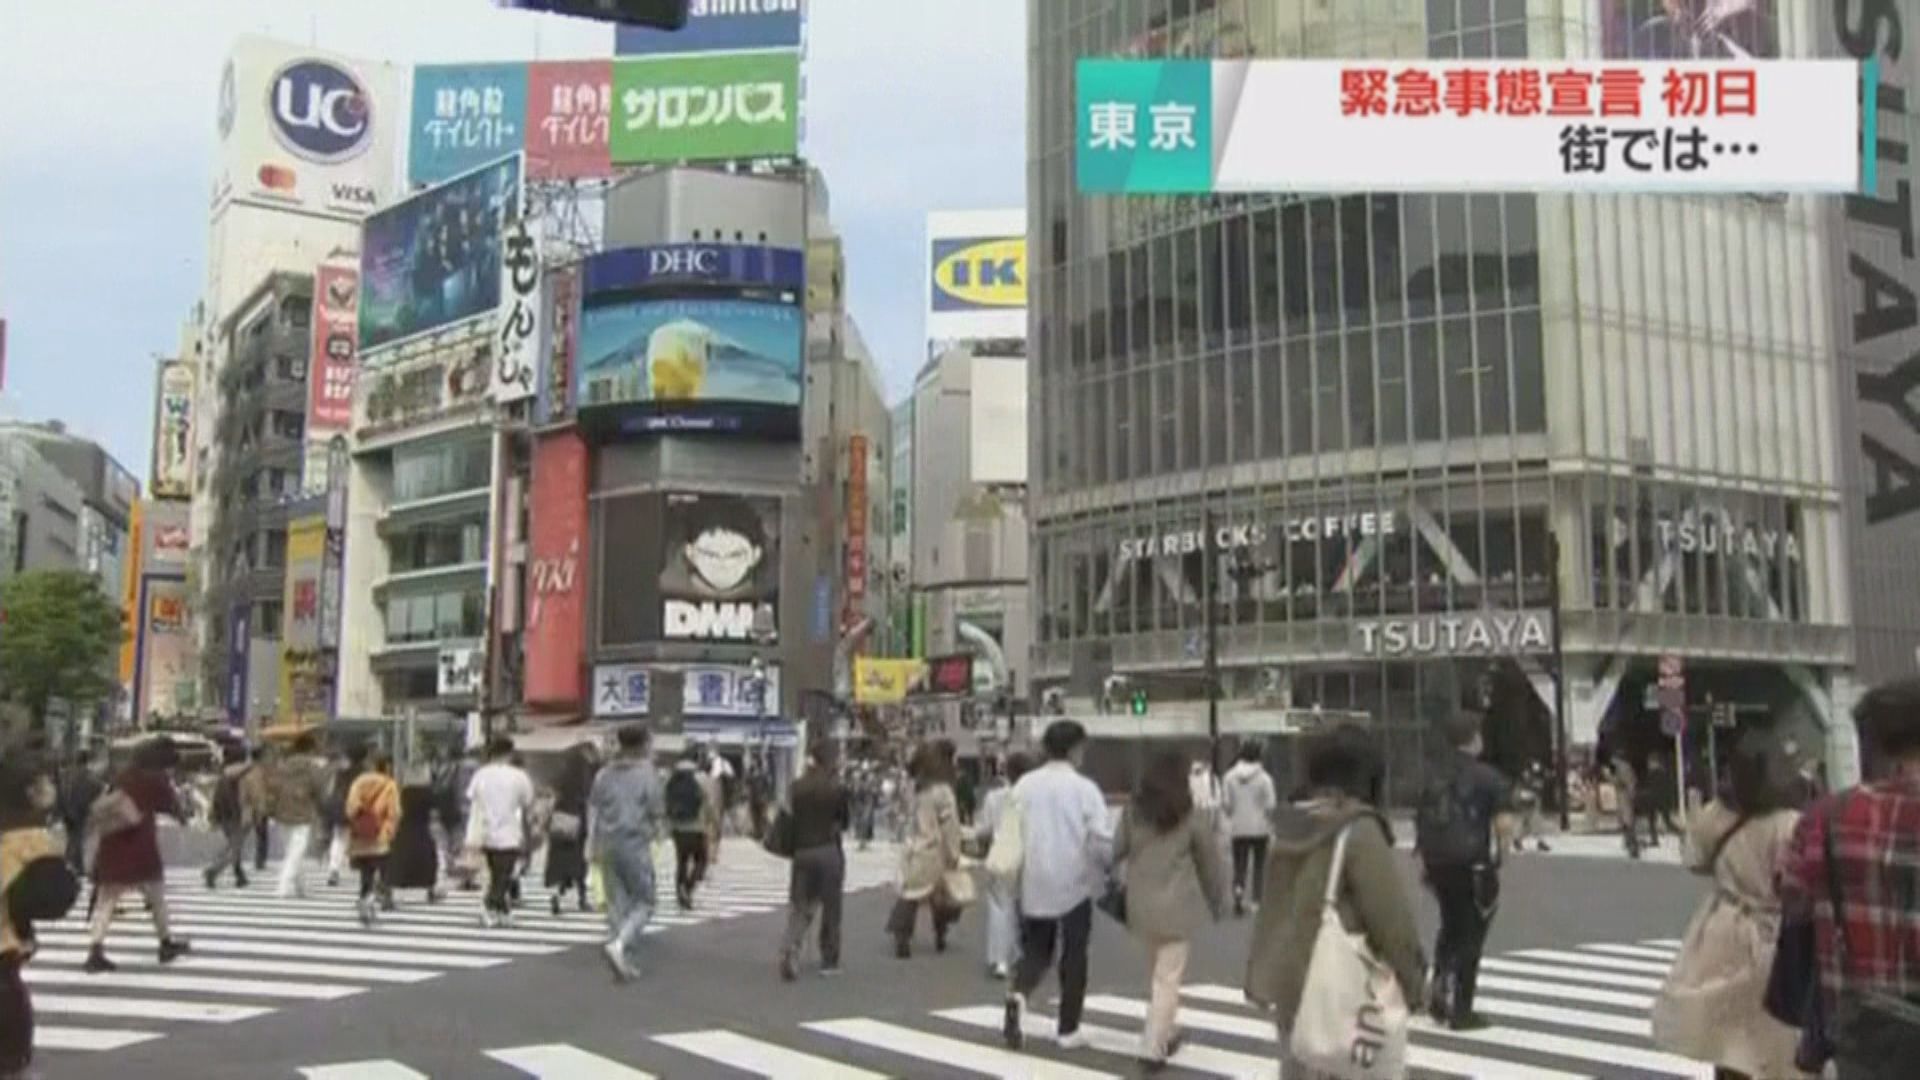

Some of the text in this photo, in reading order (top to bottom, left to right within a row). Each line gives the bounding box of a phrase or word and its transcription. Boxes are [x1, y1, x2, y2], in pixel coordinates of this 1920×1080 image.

[277, 77, 365, 136] UC
[623, 83, 786, 130] サロンパス
[331, 183, 377, 205] VISA
[650, 250, 718, 273] DHC
[952, 258, 1022, 286] IK
[503, 220, 538, 393] もんじゃ
[1658, 519, 1801, 561] TSUTAYA
[1358, 614, 1548, 653] TSUTAYA
